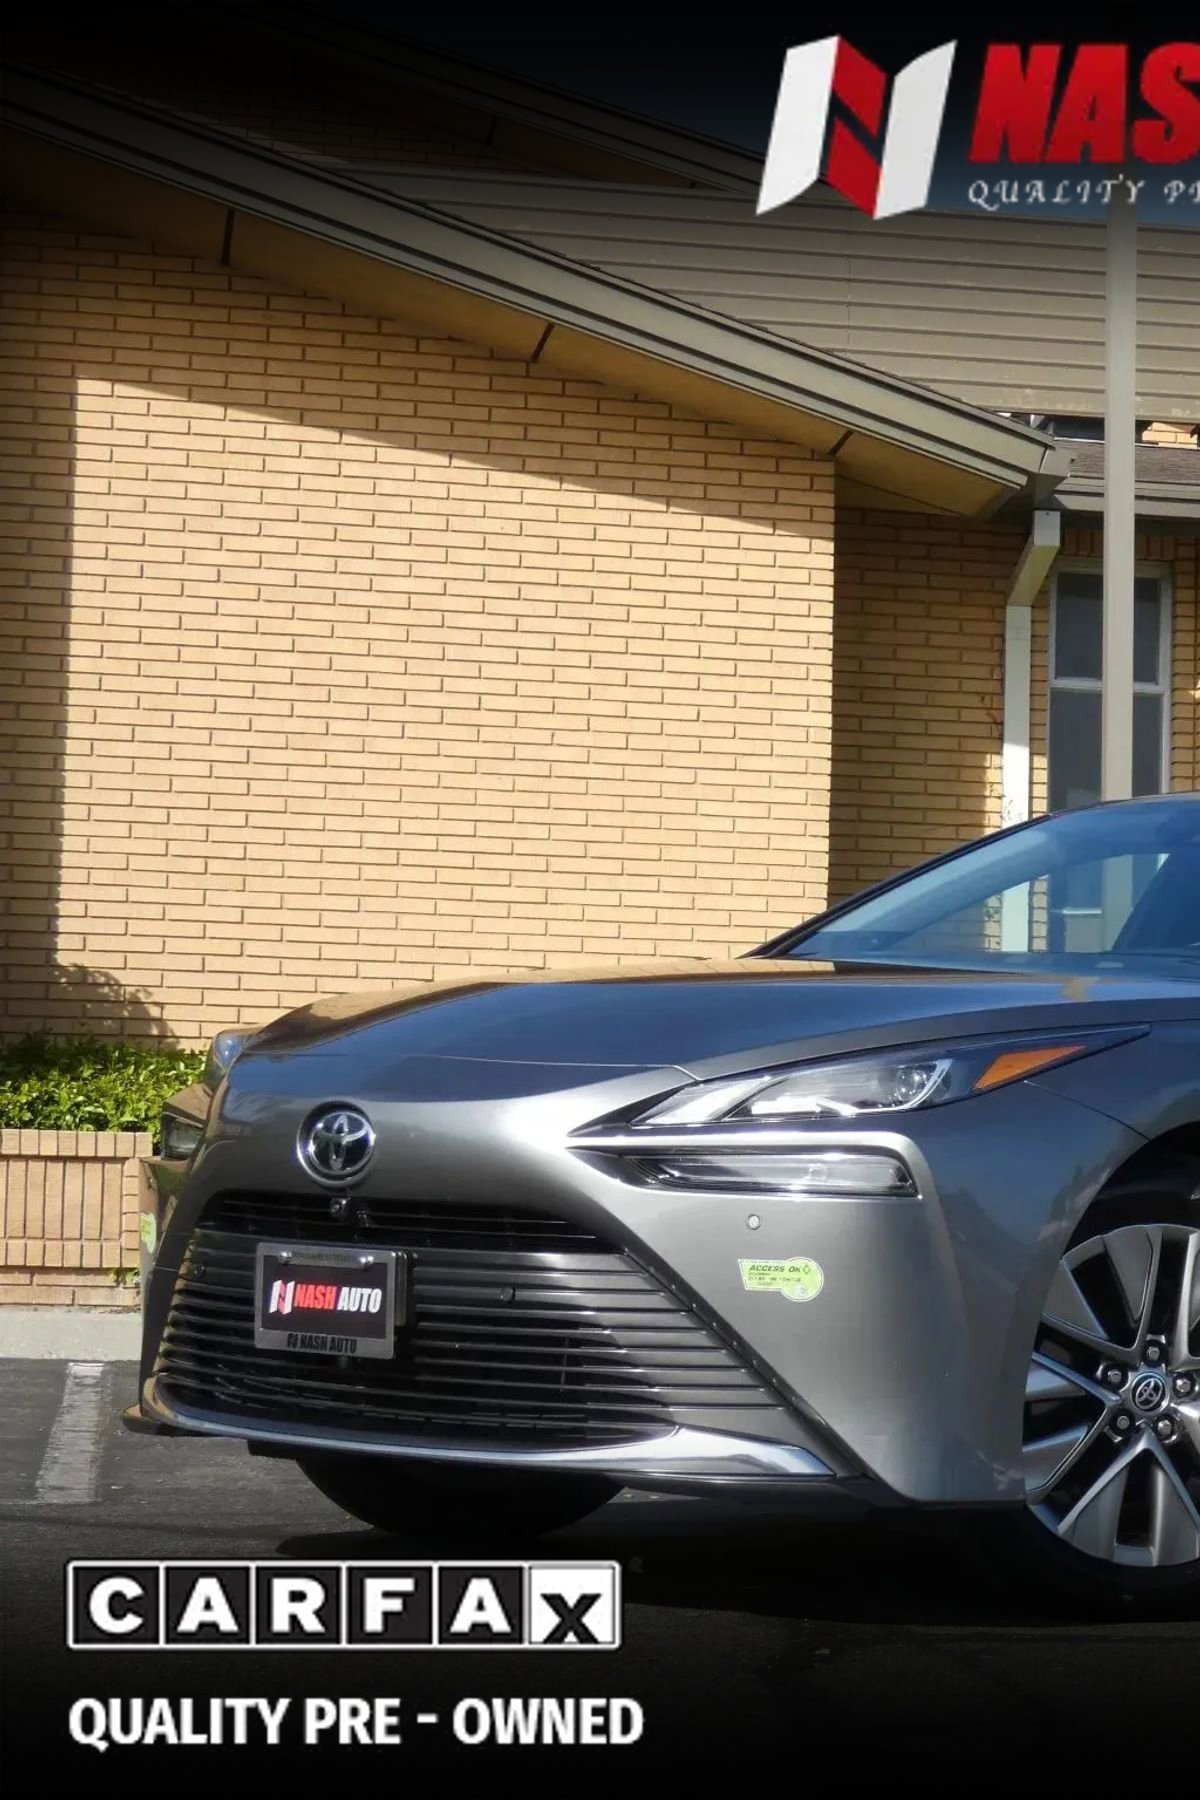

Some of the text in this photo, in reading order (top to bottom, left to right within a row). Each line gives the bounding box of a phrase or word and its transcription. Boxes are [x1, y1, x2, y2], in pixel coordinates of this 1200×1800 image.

[749, 1264, 801, 1273] ACCESS OK
[294, 1283, 337, 1310] NASH
[337, 1286, 382, 1314] AUTO
[301, 1333, 328, 1351] NASH
[329, 1337, 357, 1354] AUTO
